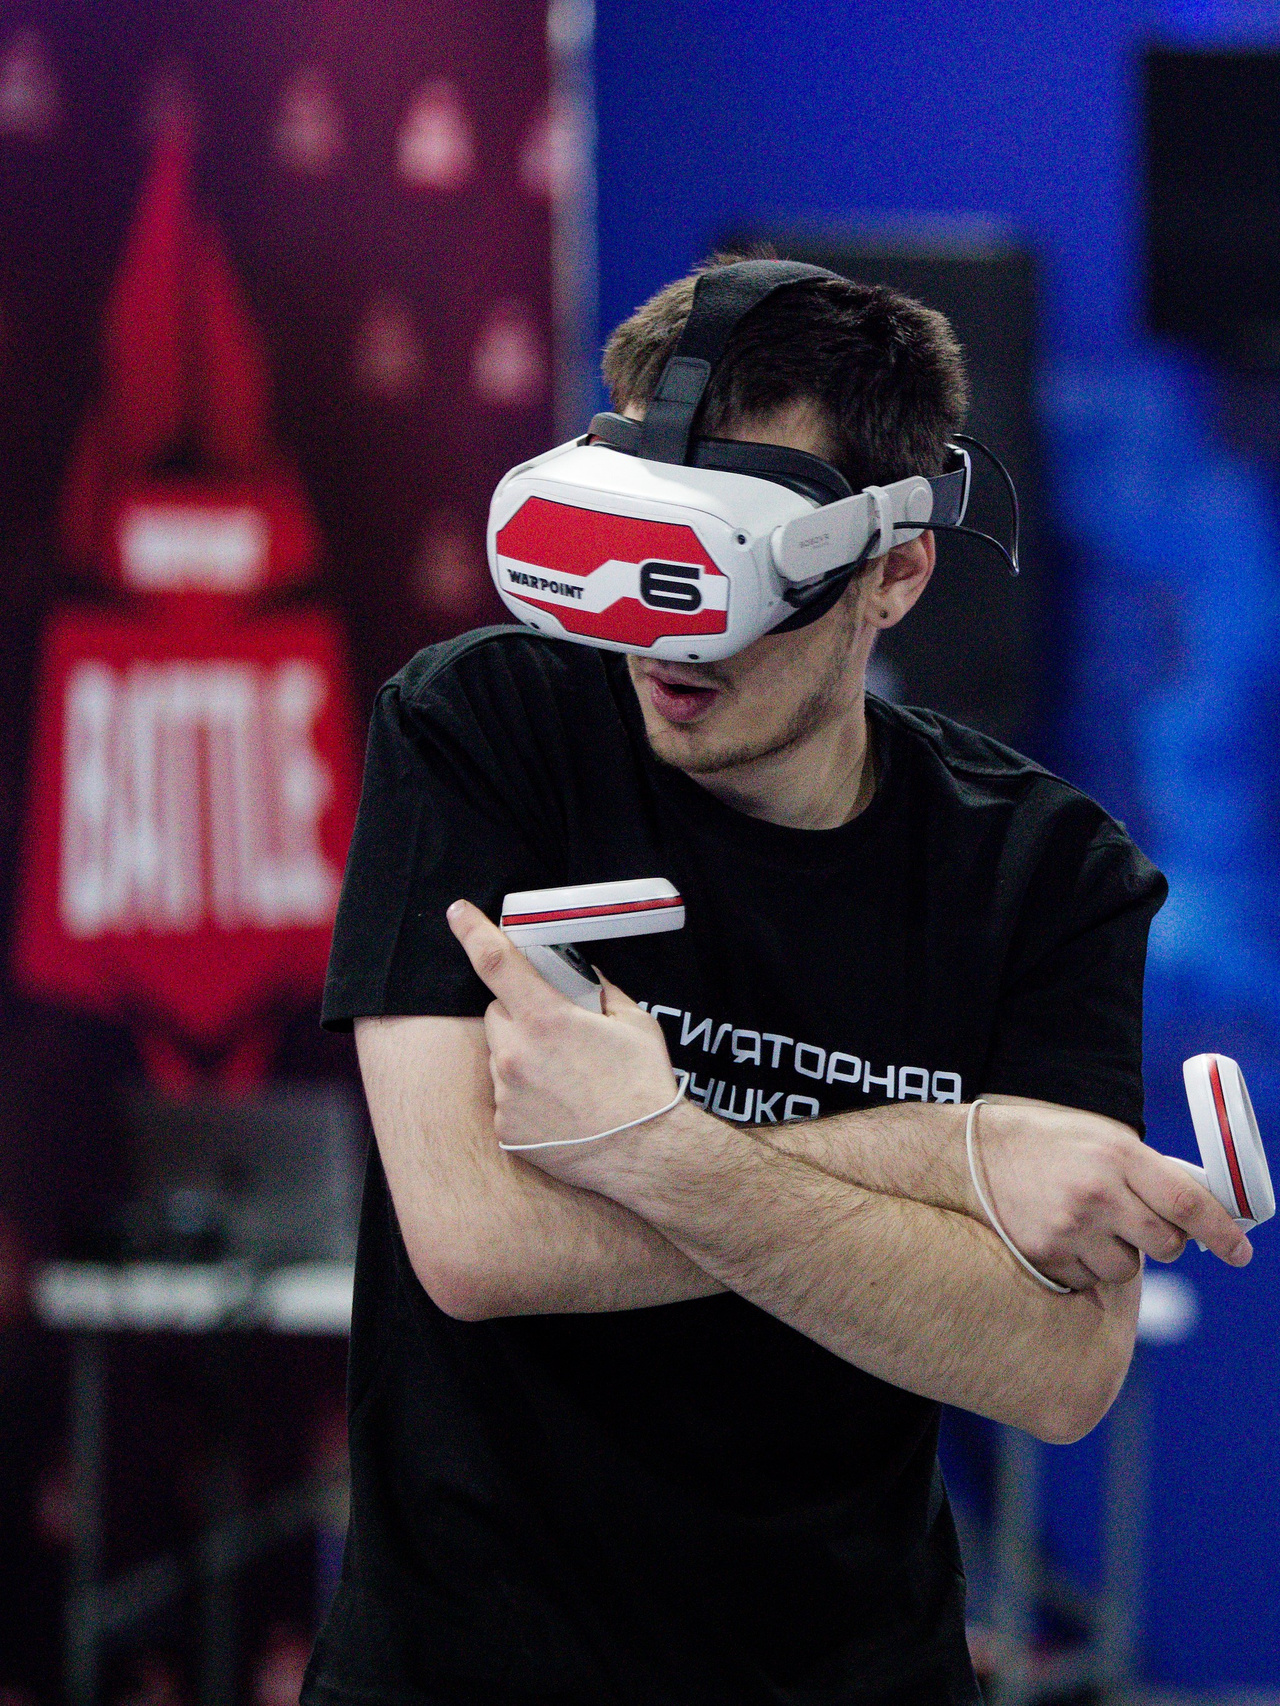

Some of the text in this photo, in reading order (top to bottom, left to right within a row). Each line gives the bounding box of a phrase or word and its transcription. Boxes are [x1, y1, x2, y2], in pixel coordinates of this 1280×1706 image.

[507, 568, 585, 600] WARPOINT
[639, 561, 703, 612] 6
[64, 660, 340, 932] BATTLE
